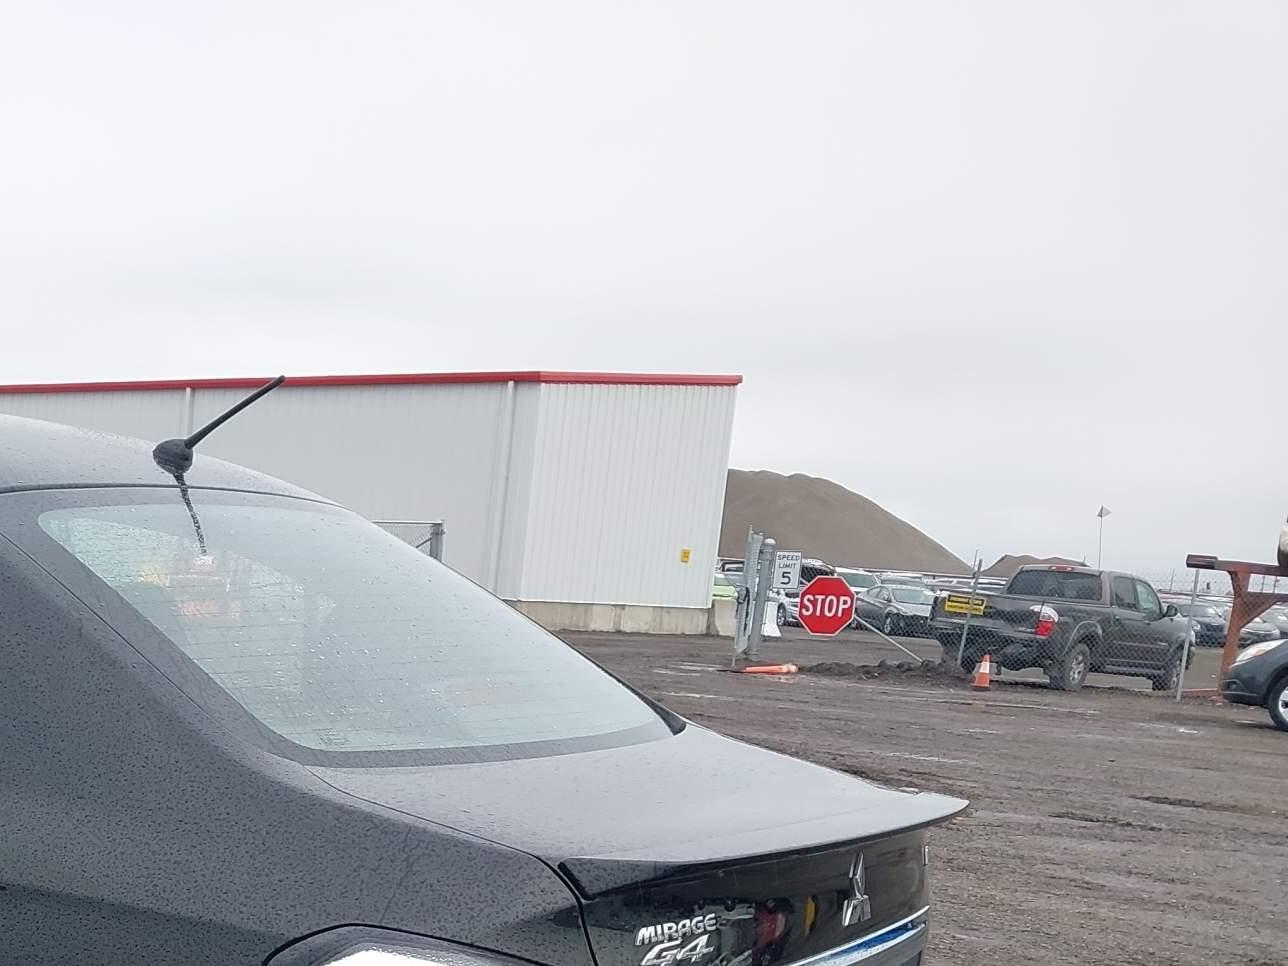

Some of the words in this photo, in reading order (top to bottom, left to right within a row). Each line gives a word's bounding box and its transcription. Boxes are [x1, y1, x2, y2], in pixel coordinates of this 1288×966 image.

[780, 571, 792, 585] 5
[801, 594, 852, 618] STOP
[635, 912, 717, 946] MIRAGE
